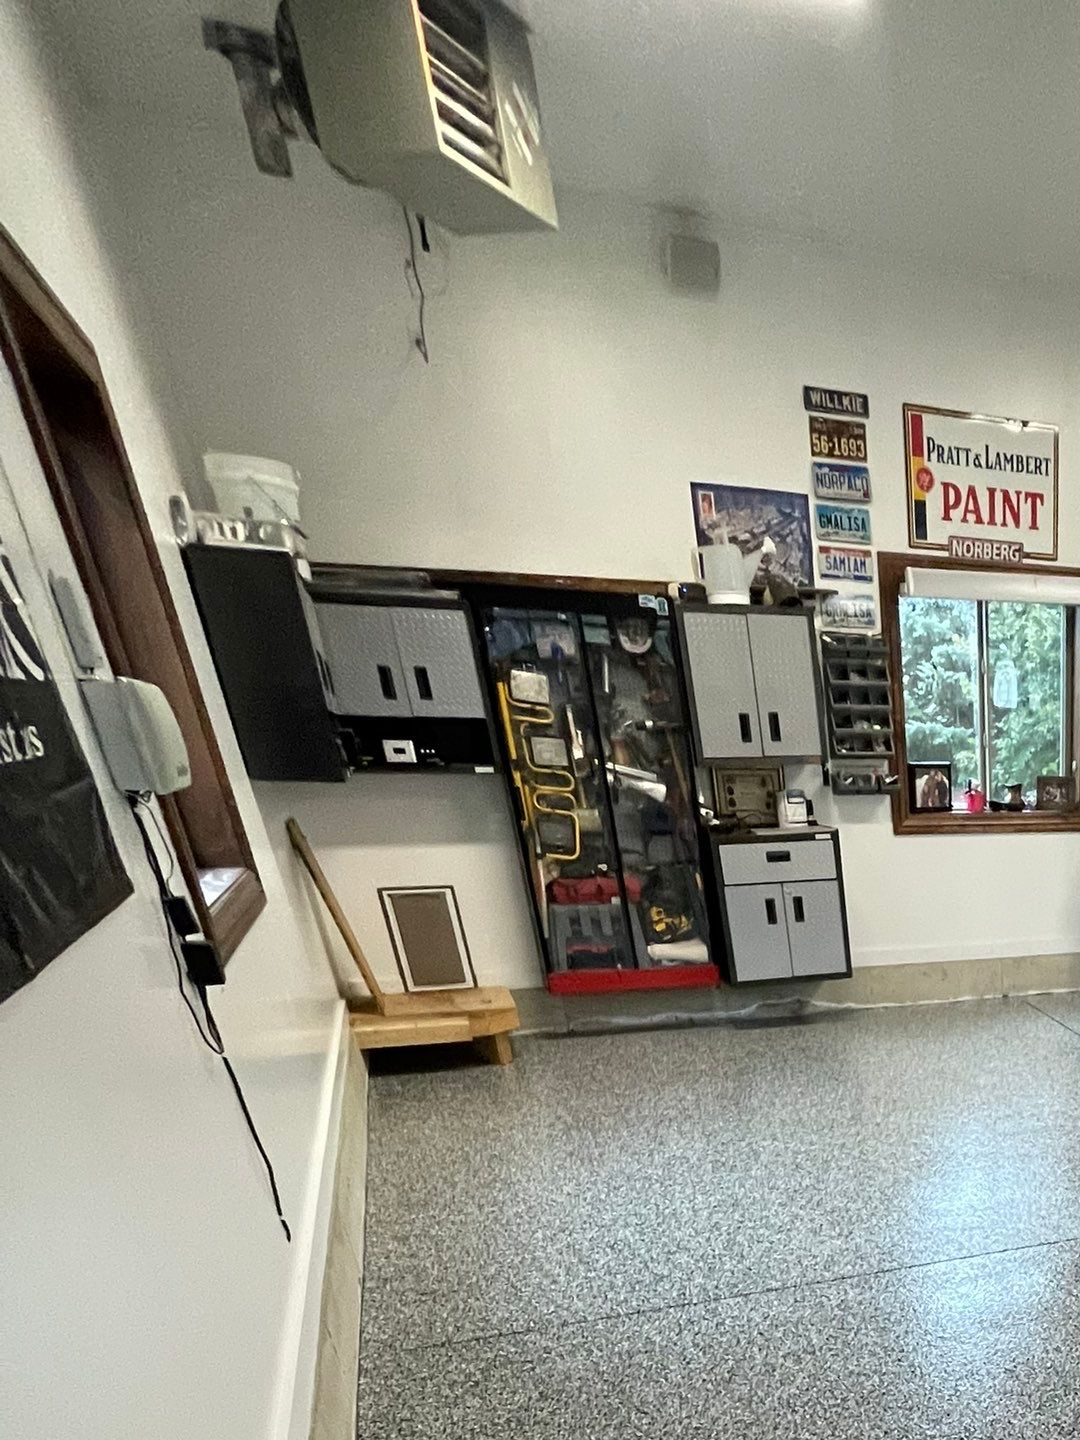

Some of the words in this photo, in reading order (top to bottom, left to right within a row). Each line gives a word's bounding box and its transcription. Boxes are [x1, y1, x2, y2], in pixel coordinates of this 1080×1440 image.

[809, 390, 865, 413] WILLKIE
[940, 481, 1045, 531] PAINT
[818, 512, 868, 533] GMALISA
[952, 539, 1020, 561] NORBERG
